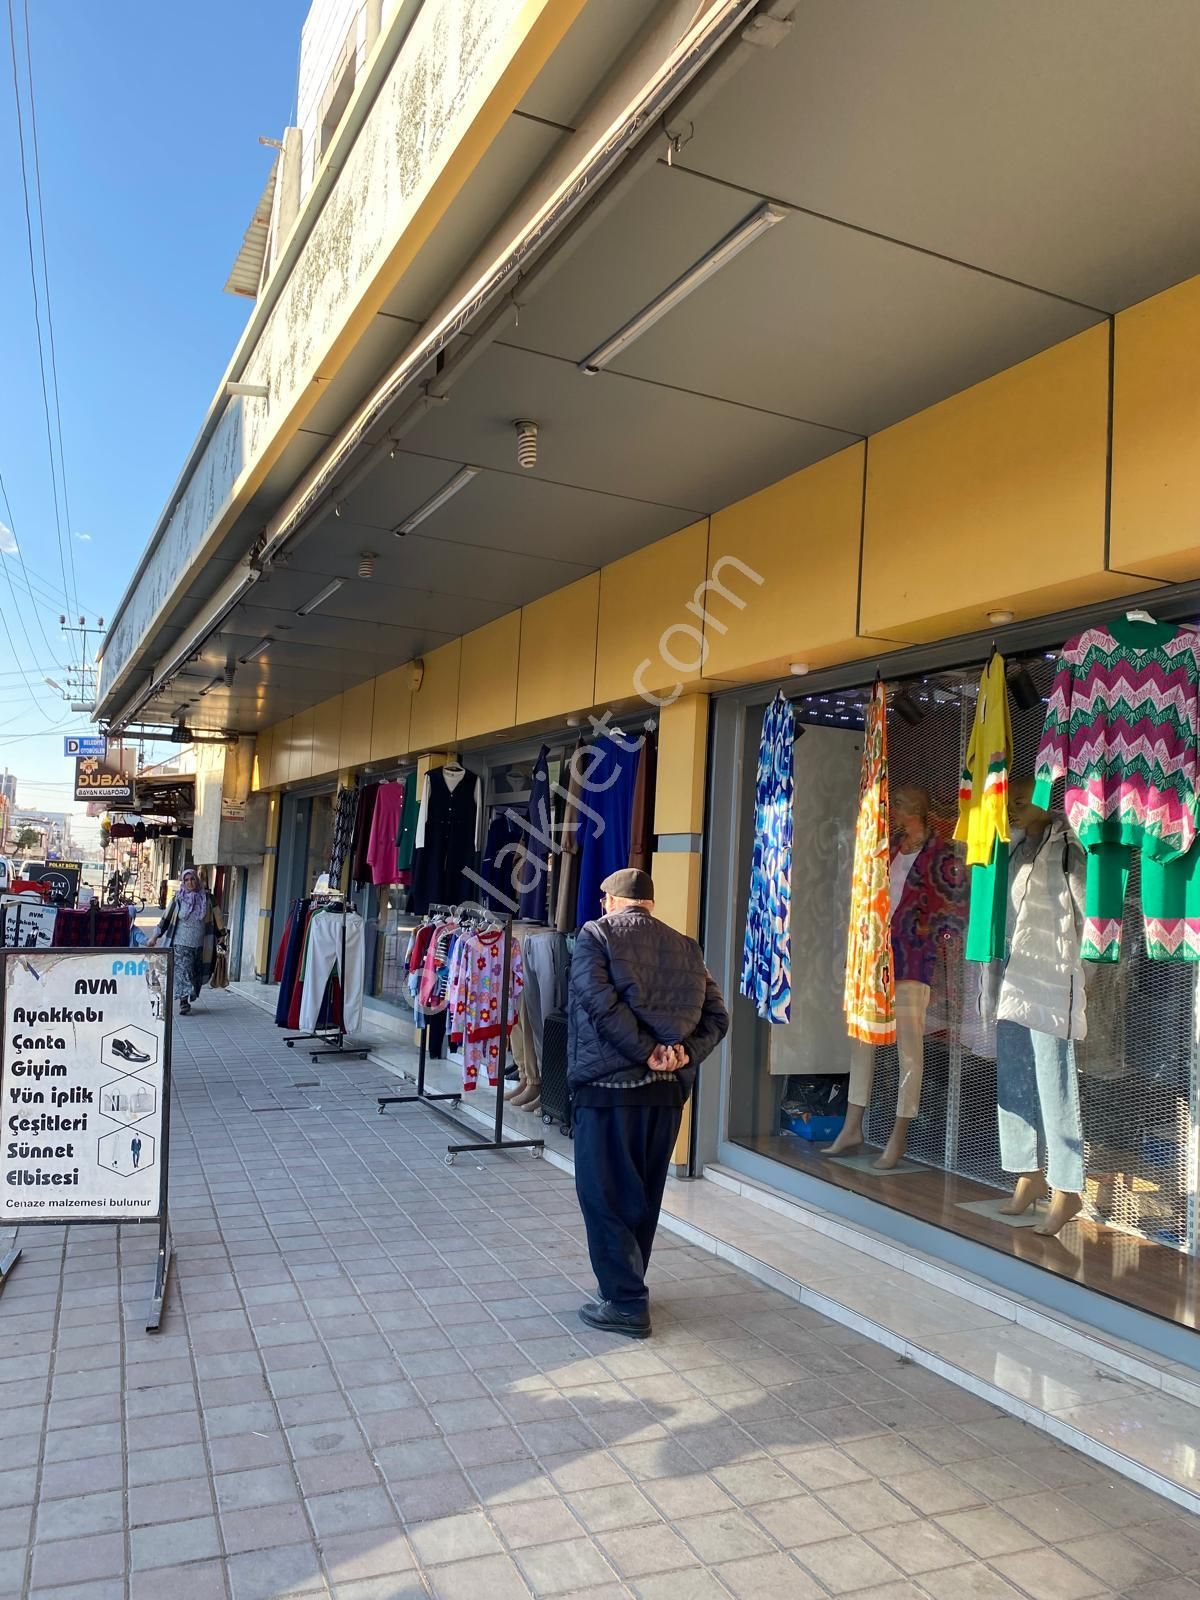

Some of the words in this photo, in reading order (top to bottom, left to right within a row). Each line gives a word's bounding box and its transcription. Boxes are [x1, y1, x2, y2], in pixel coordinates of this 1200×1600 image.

[68, 740, 79, 752] D
[74, 978, 118, 995] AVM
[13, 1006, 104, 1027] Ayakkabı
[12, 1034, 66, 1054] Çanta
[11, 1059, 68, 1080] Giyim
[9, 1087, 45, 1104] Yün
[51, 1086, 94, 1107] iplik
[8, 1113, 88, 1136] Çeşitleri
[7, 1143, 74, 1159] Sünnet
[6, 1168, 79, 1186] Elbisesi
[6, 1198, 46, 1208] Cenaze
[48, 1198, 107, 1208] malzemesi
[110, 1198, 152, 1207] bulunur
